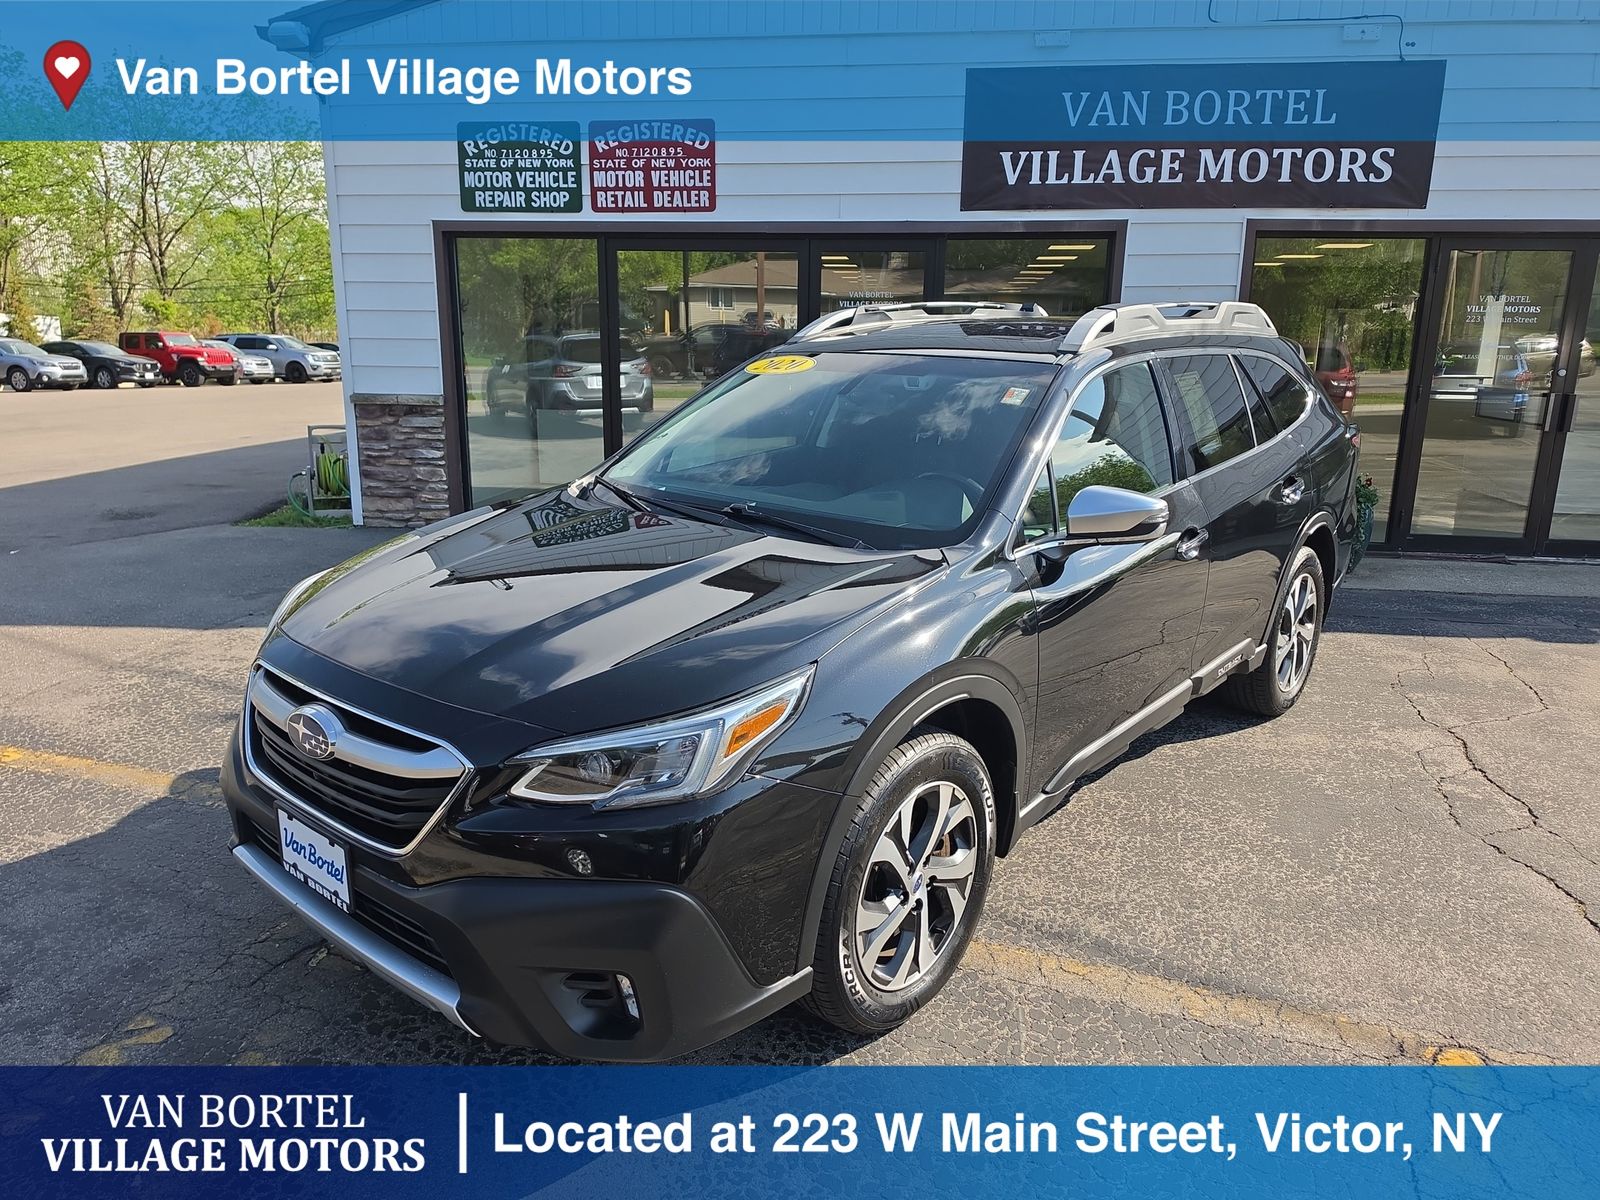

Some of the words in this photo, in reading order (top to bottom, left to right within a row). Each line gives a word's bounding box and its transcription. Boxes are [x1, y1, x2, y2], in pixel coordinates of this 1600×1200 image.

[1062, 90, 1149, 127] VAN
[1163, 88, 1337, 126] BORTEL
[463, 123, 574, 157] REGISTERED
[593, 121, 711, 153] REGISTERED
[484, 149, 498, 158] NO.
[501, 149, 553, 159] 7120895
[616, 148, 630, 158] NO.
[632, 147, 684, 157] 7120895
[464, 159, 496, 168] STATE
[500, 159, 515, 168] OF
[518, 159, 544, 168] NEW
[546, 159, 575, 168] YORK
[593, 159, 629, 168] STATE
[632, 159, 647, 168] OF
[651, 159, 676, 168] NEW
[680, 158, 712, 168] YORK
[1000, 148, 1185, 185] VILLAGE
[1196, 147, 1395, 184] MOTORS
[464, 171, 513, 188] MOTOR
[515, 171, 577, 188] VEHICLE
[593, 171, 645, 188] MOTOR
[651, 170, 712, 187] VEHICLE
[475, 191, 526, 208] REPAIR
[531, 191, 570, 208] SHOP
[596, 191, 648, 208] RETAIL
[653, 190, 710, 208] DEALER
[865, 291, 894, 299] BORTEL
[1480, 295, 1498, 303] VAN
[1504, 305, 1542, 313] MOTORS
[1466, 315, 1481, 323] 223
[1514, 315, 1538, 323] Street
[282, 860, 305, 882] VAN
[307, 877, 350, 914] BORTEL
